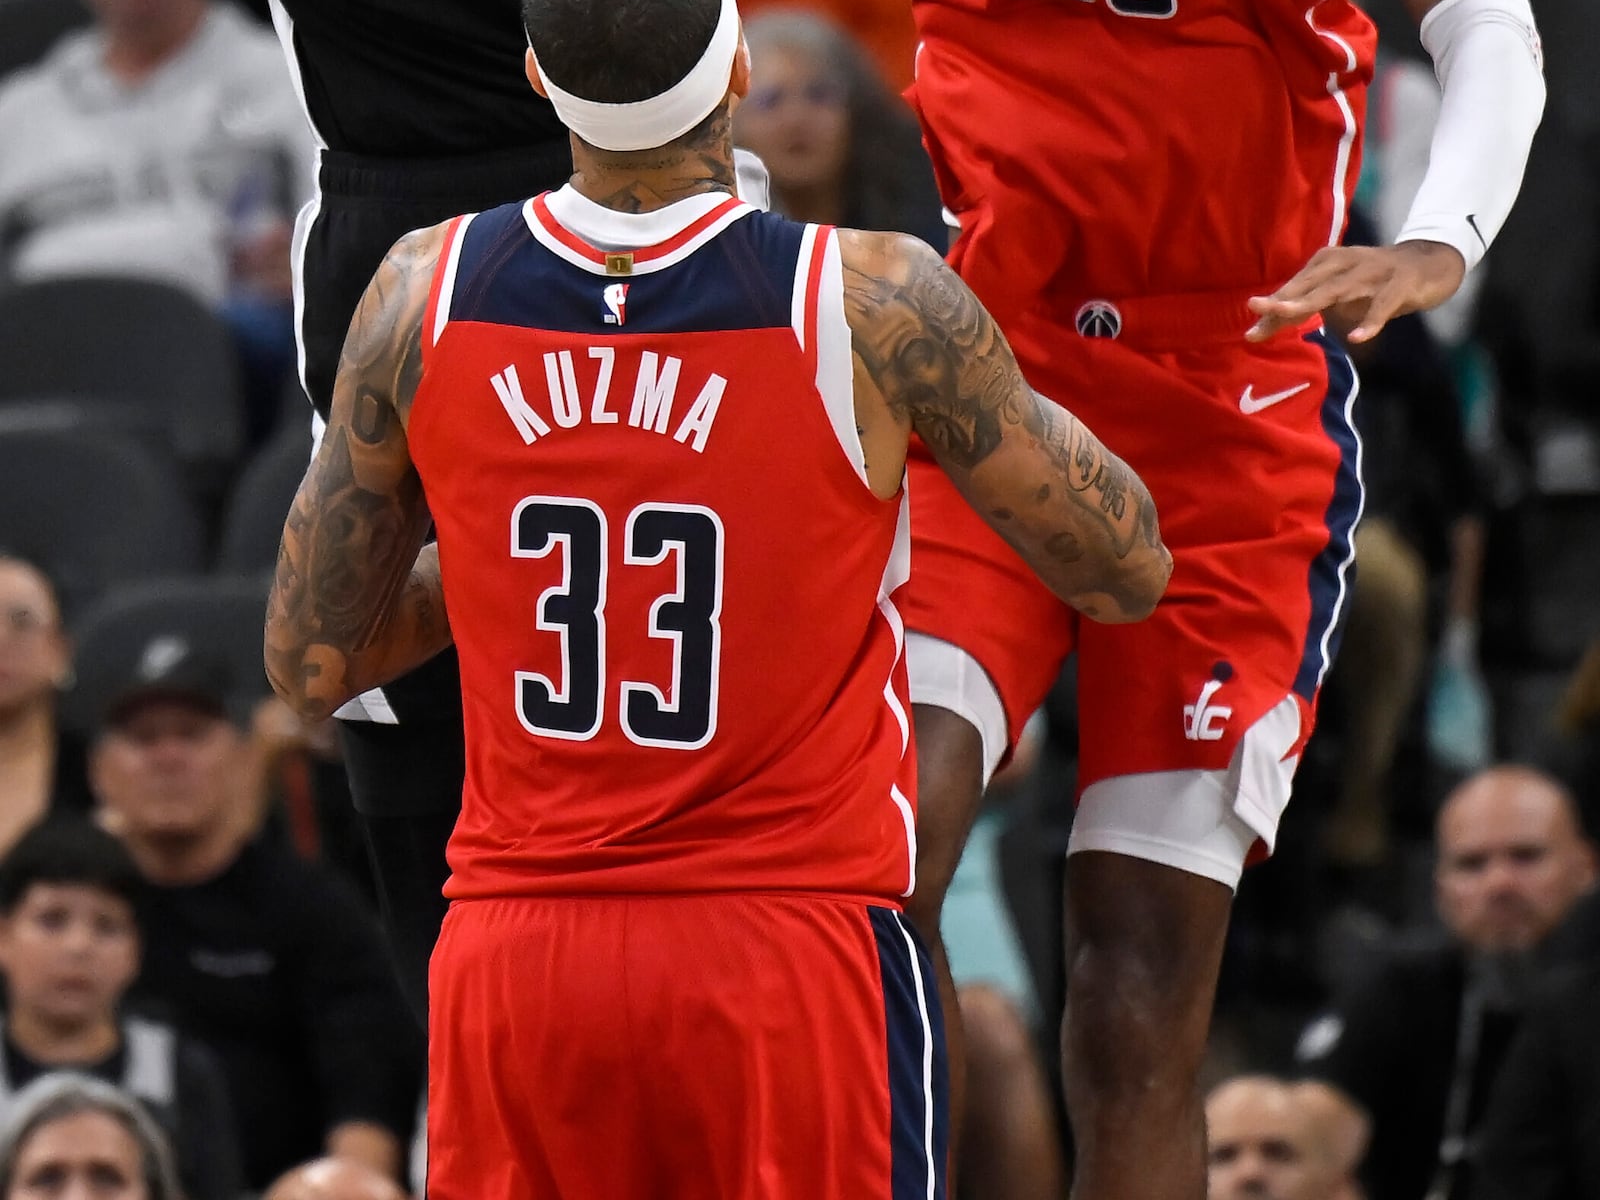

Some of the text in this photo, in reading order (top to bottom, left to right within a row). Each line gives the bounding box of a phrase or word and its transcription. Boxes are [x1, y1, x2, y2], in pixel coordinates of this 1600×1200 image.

[489, 346, 728, 454] KUZMA
[510, 494, 725, 750] 33
[1183, 679, 1232, 741] dc
